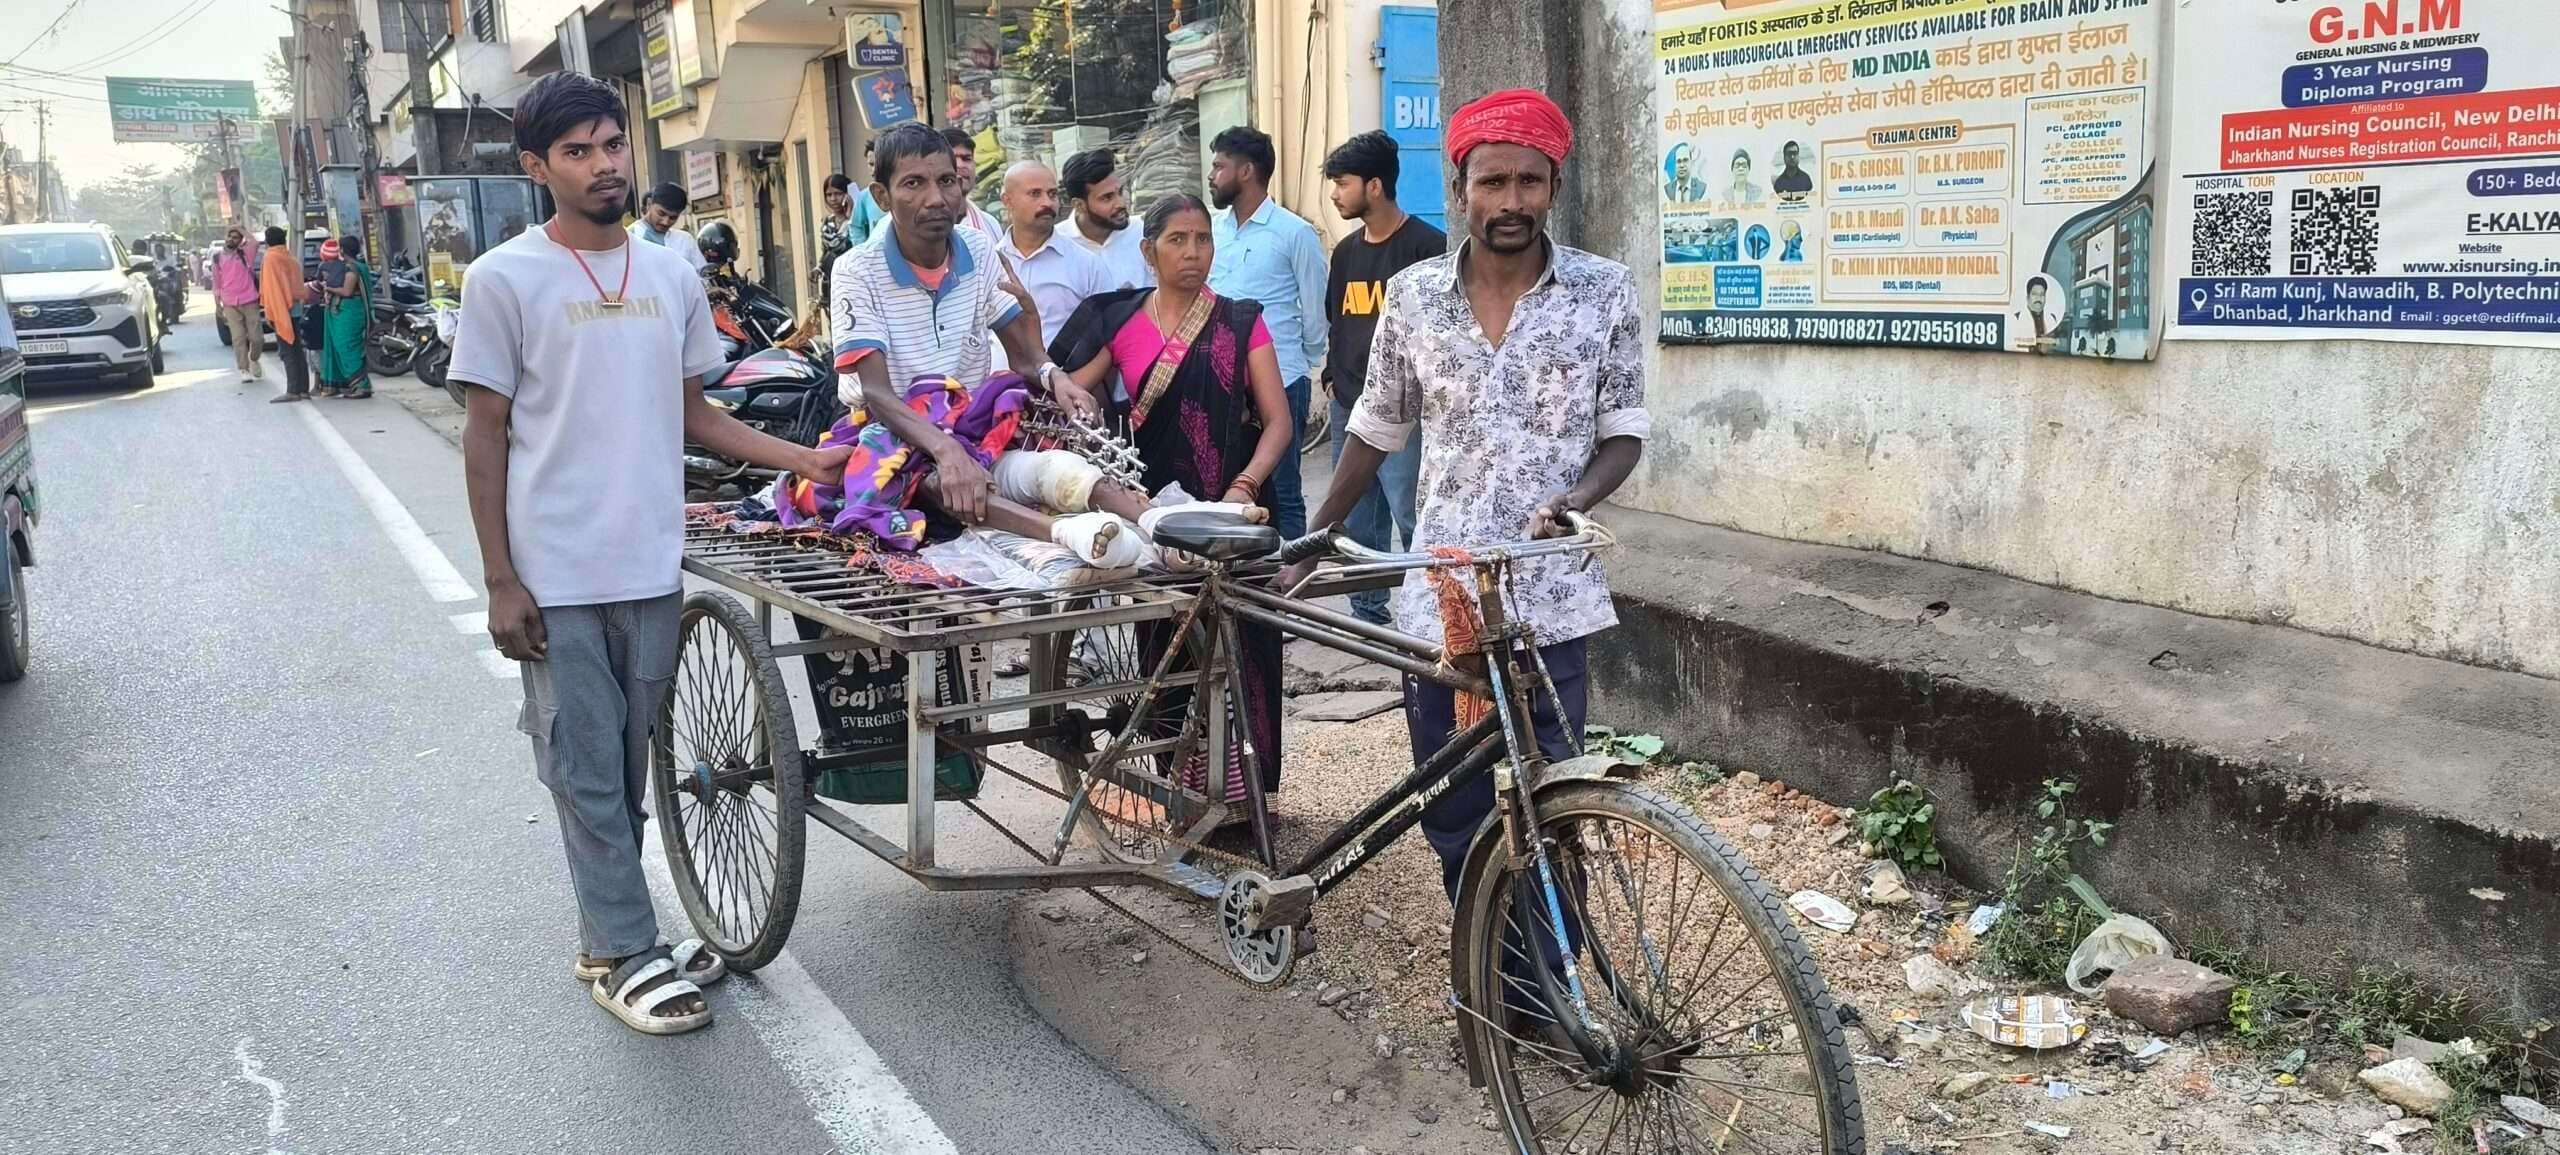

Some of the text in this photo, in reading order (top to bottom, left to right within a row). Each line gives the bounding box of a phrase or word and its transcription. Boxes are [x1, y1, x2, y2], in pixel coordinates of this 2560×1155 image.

[1661, 31, 1685, 51] हमारे
[1688, 26, 1706, 45] यहाँ
[1709, 20, 1757, 42] FORTIS
[1760, 14, 1808, 33] अस्पताल
[1811, 8, 1823, 24] के
[1827, 4, 1844, 24] डॉ.
[2309, 0, 2463, 44] G.N.M
[1664, 0, 2100, 75] 24 HOURS NEUROSURGICAL EMERGENCY SERVICES AVAILABLE FOR BRAIN AND
[2296, 33, 2480, 61] GENERAL NURSING & MIDWIFERY
[1675, 78, 1715, 102] रिटायर
[1719, 73, 1744, 96] सेल
[1798, 62, 1814, 83] के
[1819, 57, 1848, 83] लिए
[1852, 56, 1878, 78] MD
[1883, 50, 1930, 75] INDIA
[1936, 37, 1972, 67] कार्ड
[1977, 40, 2012, 66] द्वारा
[2313, 56, 2452, 81] 3 Year Nursing
[1664, 108, 1681, 131] की
[1686, 105, 1724, 135] सुविधा
[1728, 102, 1749, 126] एवं
[1848, 88, 1878, 112] सेवा
[1883, 79, 1916, 107] जेपी
[1999, 73, 2036, 98] द्वारा
[2040, 61, 2061, 91] दी
[2066, 54, 2116, 87] जाती
[2301, 76, 2464, 103] Diploma Program
[2352, 103, 2405, 113] Affiliated to
[2068, 120, 2122, 131] APPROVED
[2229, 103, 2560, 143] Indian Nursing Council, New Delhi
[1872, 125, 1957, 145] TRAUMA CENTRE
[2063, 130, 2107, 140] COLLAGE
[2070, 138, 2123, 149] COLLEGE
[2228, 128, 2560, 164] Jharkhand Nurses Registration Council, Ranchi
[1918, 149, 2006, 175] Dr. B.K. PUROHIT
[2070, 161, 2122, 171] COLLEGE
[2084, 153, 2126, 161] APPROVED
[1830, 157, 1905, 180] Dr. S. GHOSAL
[2086, 175, 2127, 183] APPROVED
[2309, 171, 2364, 185] LOCATION
[1952, 177, 1984, 186] SURGEON
[2070, 185, 2121, 194] COLLEGE
[2195, 175, 2275, 190] HOSPITAL TOUR
[2477, 174, 2516, 190] 150+
[1830, 211, 1844, 229] Dr.
[1870, 208, 1904, 228] Mandi
[1921, 205, 1999, 226] Dr. A.K. Saha
[2467, 211, 2560, 233] E-KALYA
[1862, 232, 1901, 243] (Cardiologist)
[1941, 230, 1978, 242] (Physician)
[2459, 243, 2502, 253] Website
[1831, 258, 1846, 276] Dr.
[1848, 257, 1874, 276] KIMI
[1878, 256, 1943, 276] NITYANAND
[1947, 255, 1999, 275] MONDAL
[2403, 258, 2560, 276] www.xisnursing.in
[1915, 280, 1941, 291] (Dental)
[2214, 281, 2560, 304] Sri Ram Kunj, Nawadih, B. Polytechni
[2213, 304, 2293, 323] Dhanbad,
[2298, 305, 2392, 322] Jharkhand
[2400, 312, 2432, 322] Email
[1795, 318, 1887, 343] 7979018827,
[1890, 320, 1998, 345] 9279551898
[841, 708, 909, 729] EVERGREEN
[1424, 774, 1451, 803] ATLAS
